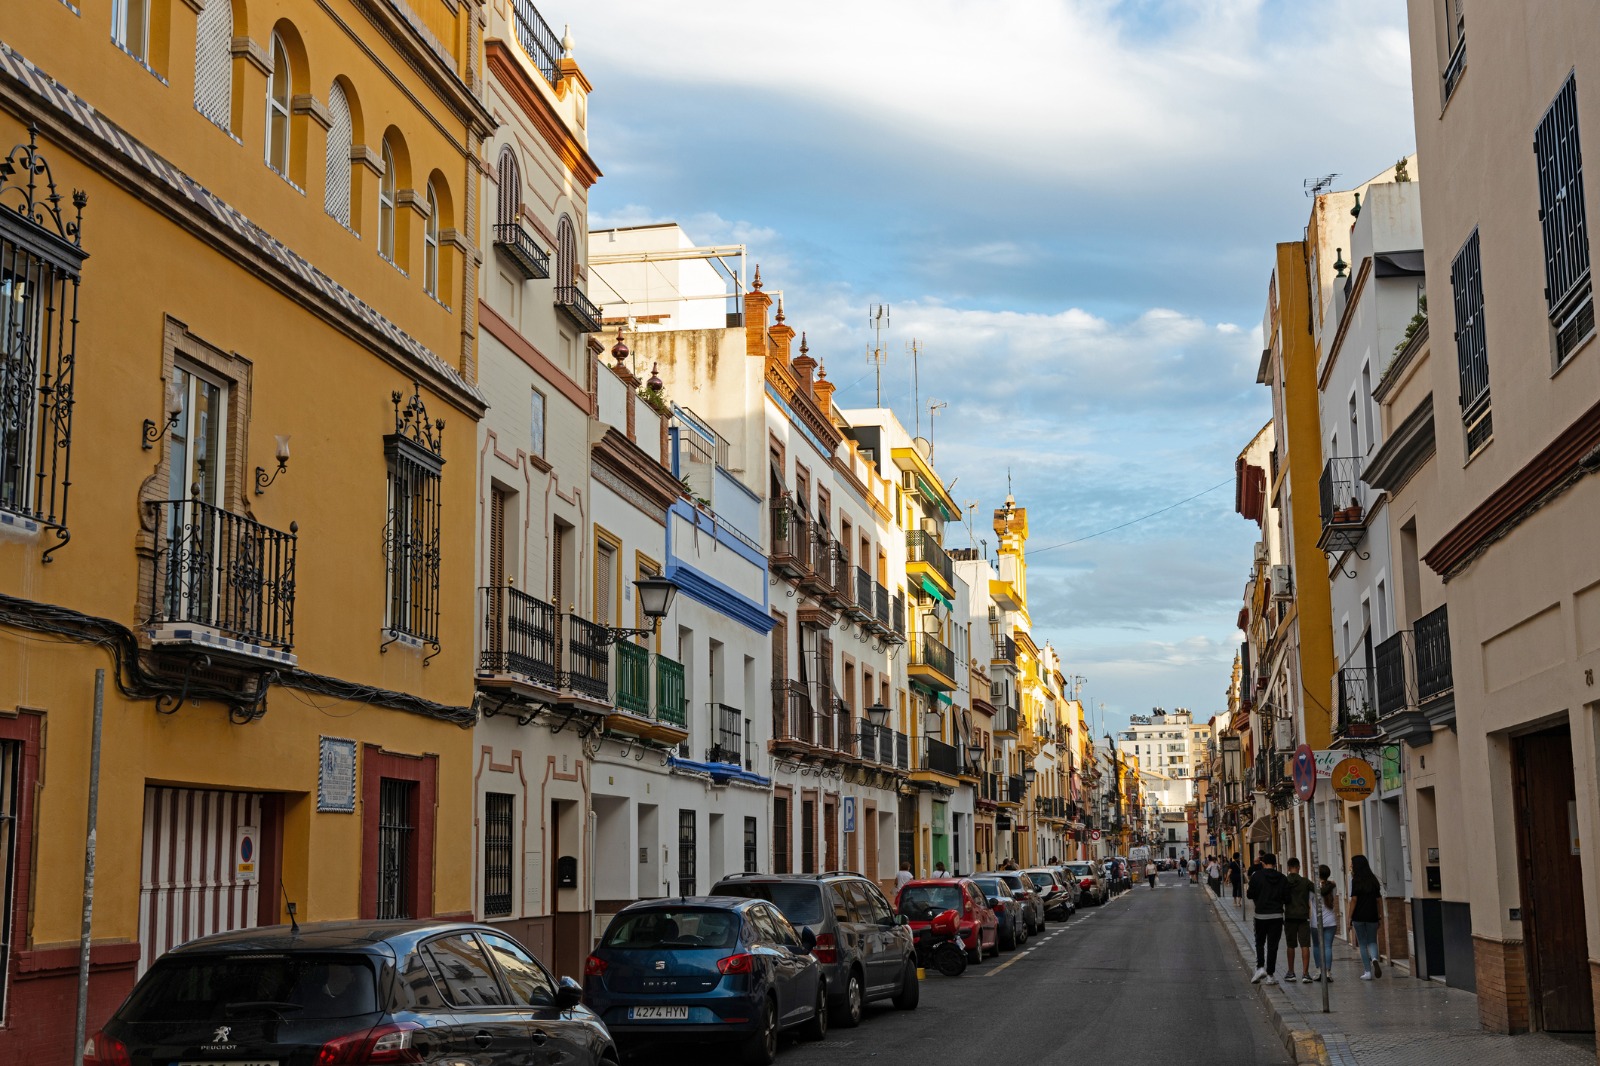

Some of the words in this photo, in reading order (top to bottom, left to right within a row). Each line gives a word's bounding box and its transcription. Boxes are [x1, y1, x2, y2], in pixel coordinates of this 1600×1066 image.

[1314, 752, 1336, 764] iclo
[845, 799, 853, 829] P
[636, 1007, 662, 1017] 4274
[665, 1007, 687, 1017] HYN
